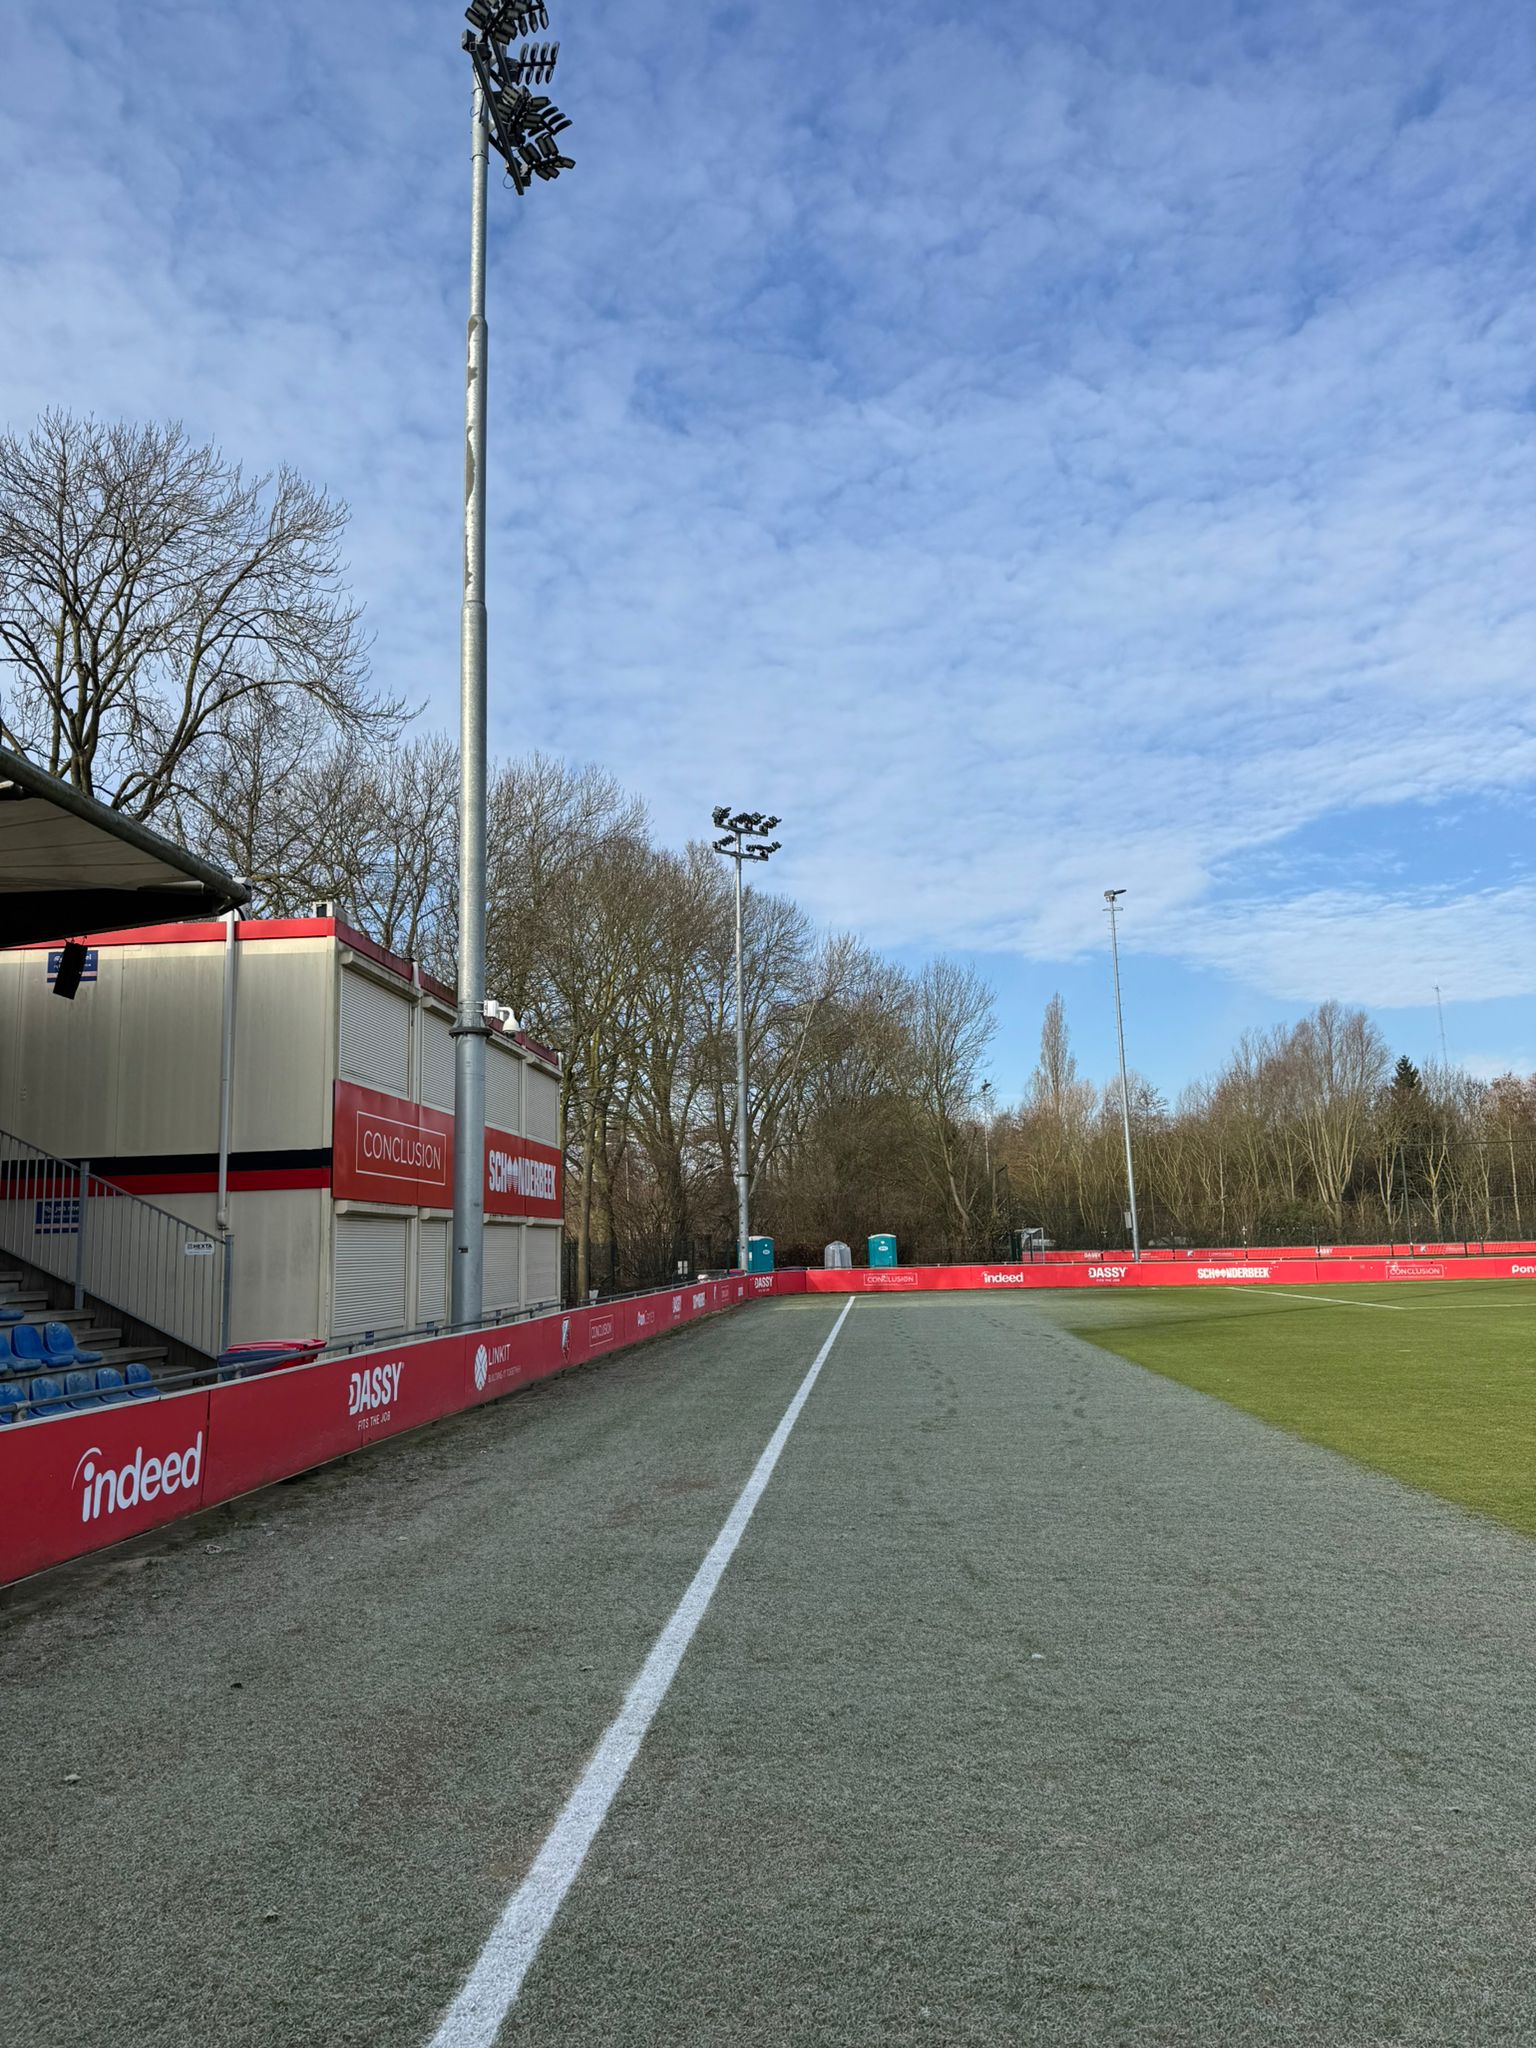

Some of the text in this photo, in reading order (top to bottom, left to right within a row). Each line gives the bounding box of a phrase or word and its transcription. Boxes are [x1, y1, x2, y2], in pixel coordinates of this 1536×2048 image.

[363, 1130, 441, 1170] CONCLUSION
[1088, 1267, 1126, 1279] DASSY
[1390, 1266, 1440, 1276] CONCLUSION
[1511, 1264, 1536, 1274] Pon
[755, 1276, 774, 1289] DASSY
[867, 1275, 914, 1284] CONCLUSION
[982, 1270, 1024, 1284] indeed
[488, 1344, 511, 1366] LINKIT
[348, 1362, 404, 1416] DASSY
[370, 1414, 380, 1427] THE
[72, 1430, 203, 1523] indeed
